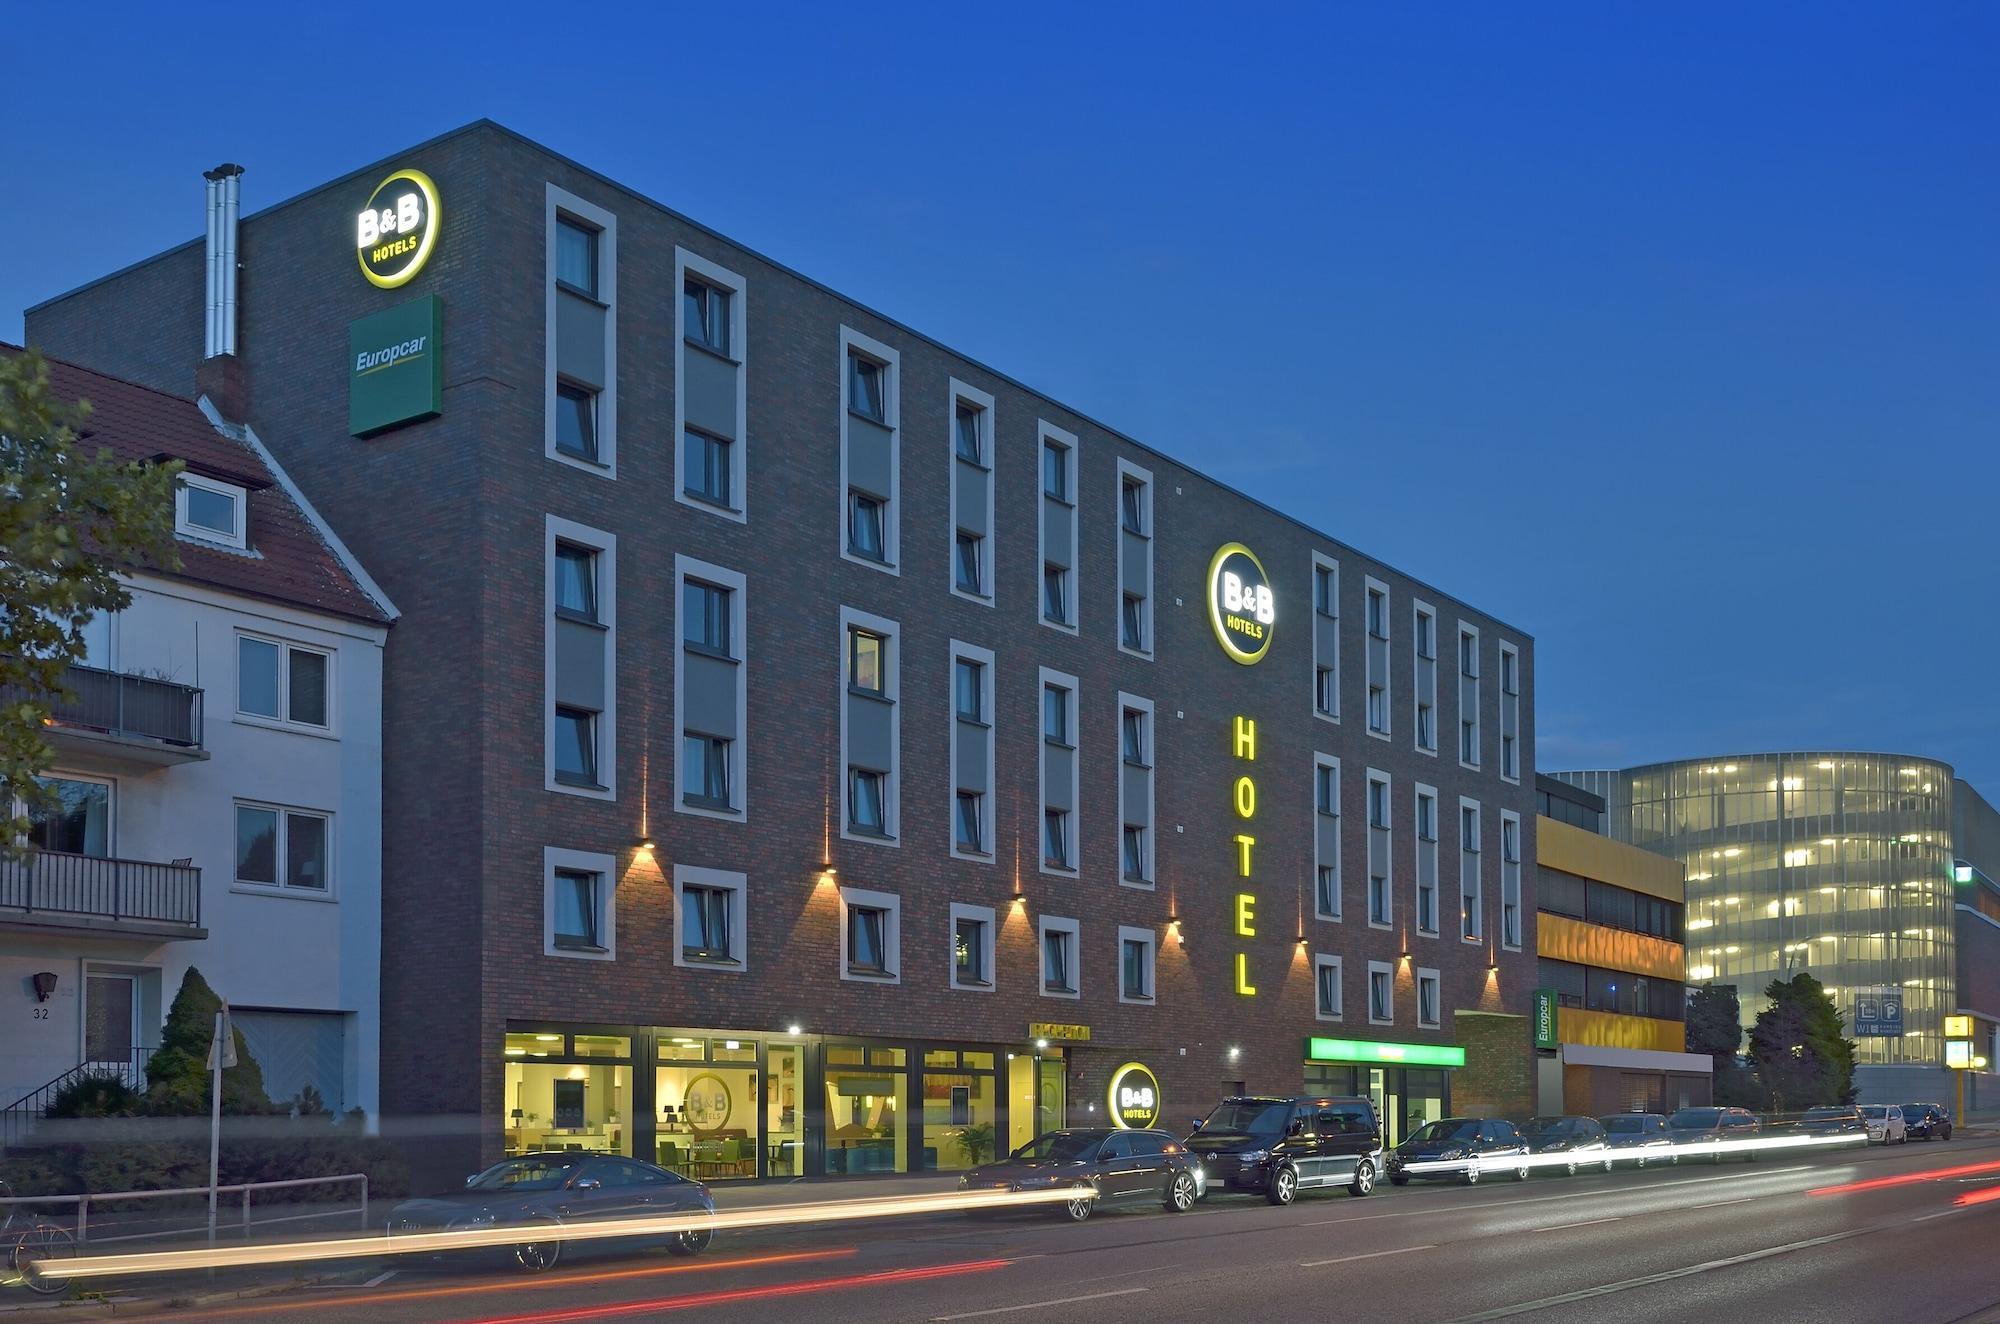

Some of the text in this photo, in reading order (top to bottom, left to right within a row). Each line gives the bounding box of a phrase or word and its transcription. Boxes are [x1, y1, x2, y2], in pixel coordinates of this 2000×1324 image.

[357, 192, 421, 249] B&B
[372, 235, 418, 263] HOTELS
[355, 335, 427, 372] Europcar
[1223, 570, 1275, 625] B&B
[1226, 614, 1263, 639] HOTELS
[1232, 715, 1256, 996] HOTEL
[33, 1008, 49, 1020] 32
[1538, 994, 1551, 1042] Europcar
[1121, 1086, 1154, 1108] B&B
[1123, 1109, 1152, 1119] HOTELS
